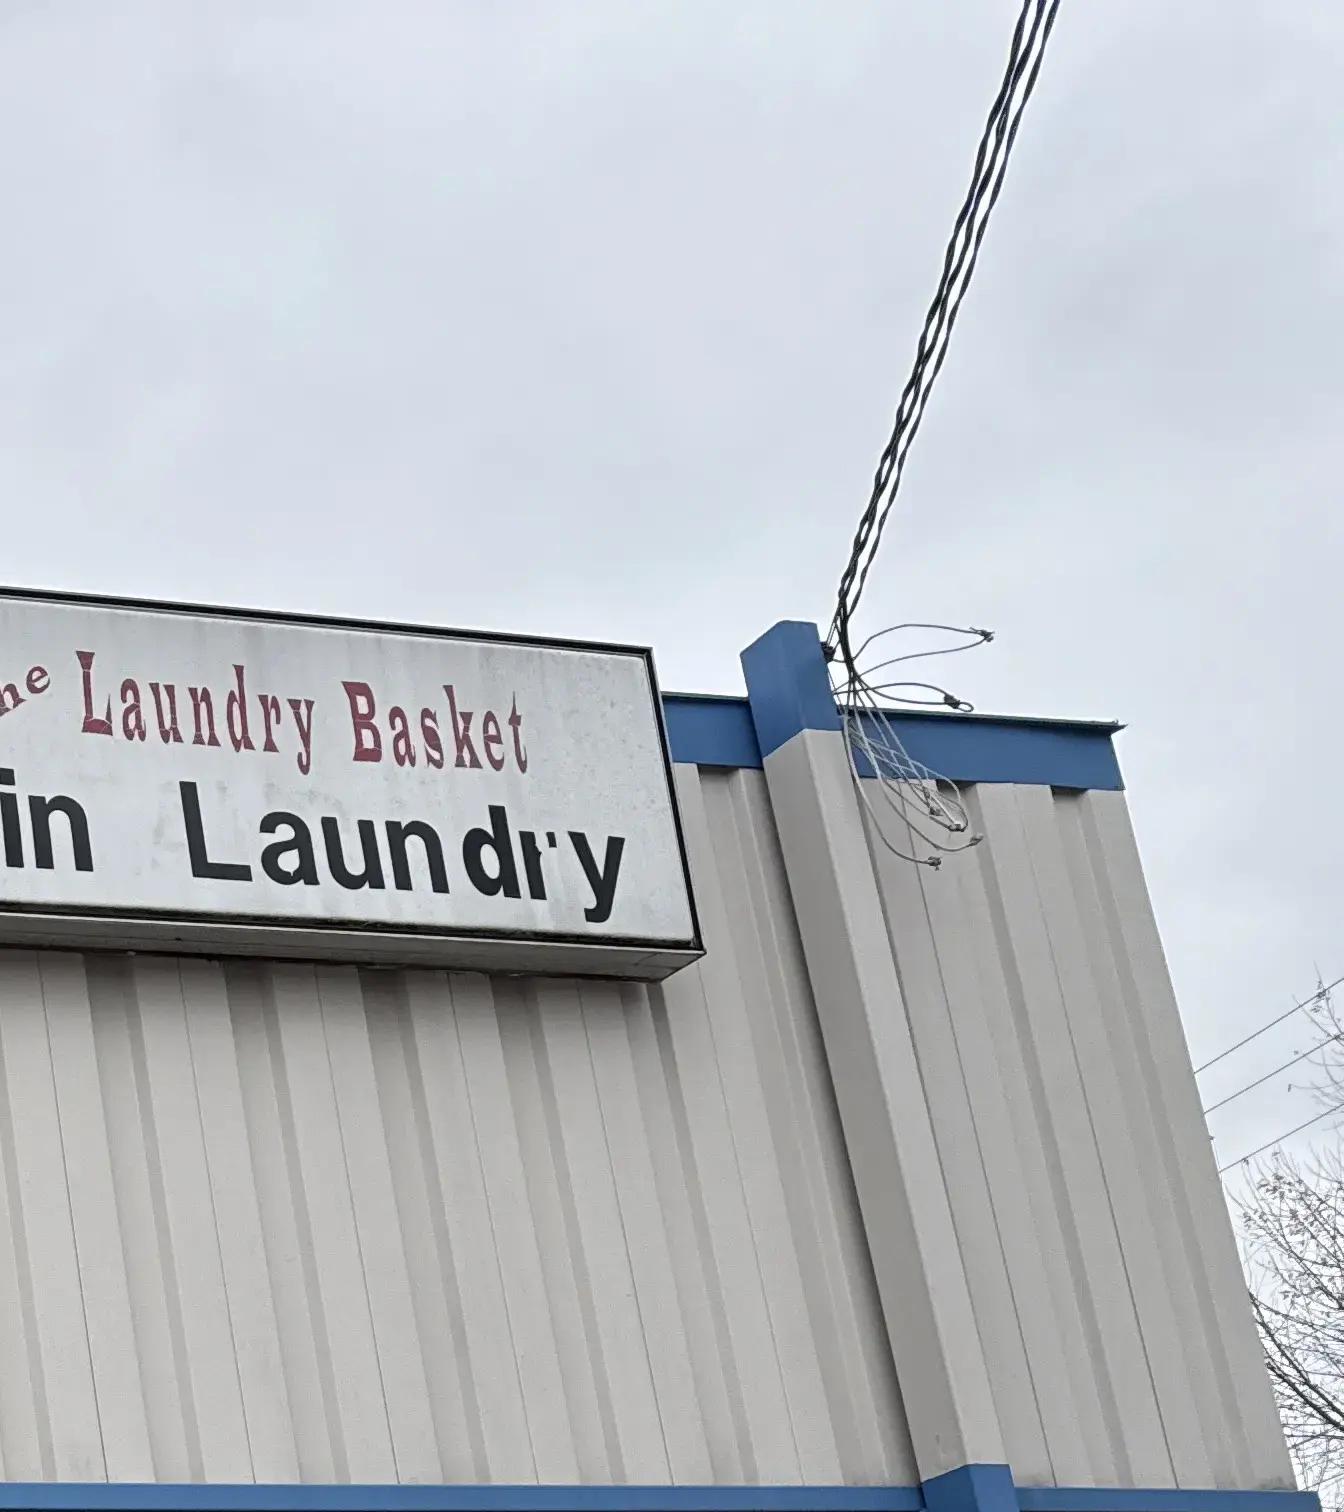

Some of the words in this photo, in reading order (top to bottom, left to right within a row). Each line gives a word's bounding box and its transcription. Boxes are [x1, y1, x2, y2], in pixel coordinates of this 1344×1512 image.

[76, 650, 316, 776] Laundry
[342, 681, 528, 775] Basket
[178, 781, 626, 923] Laundry
